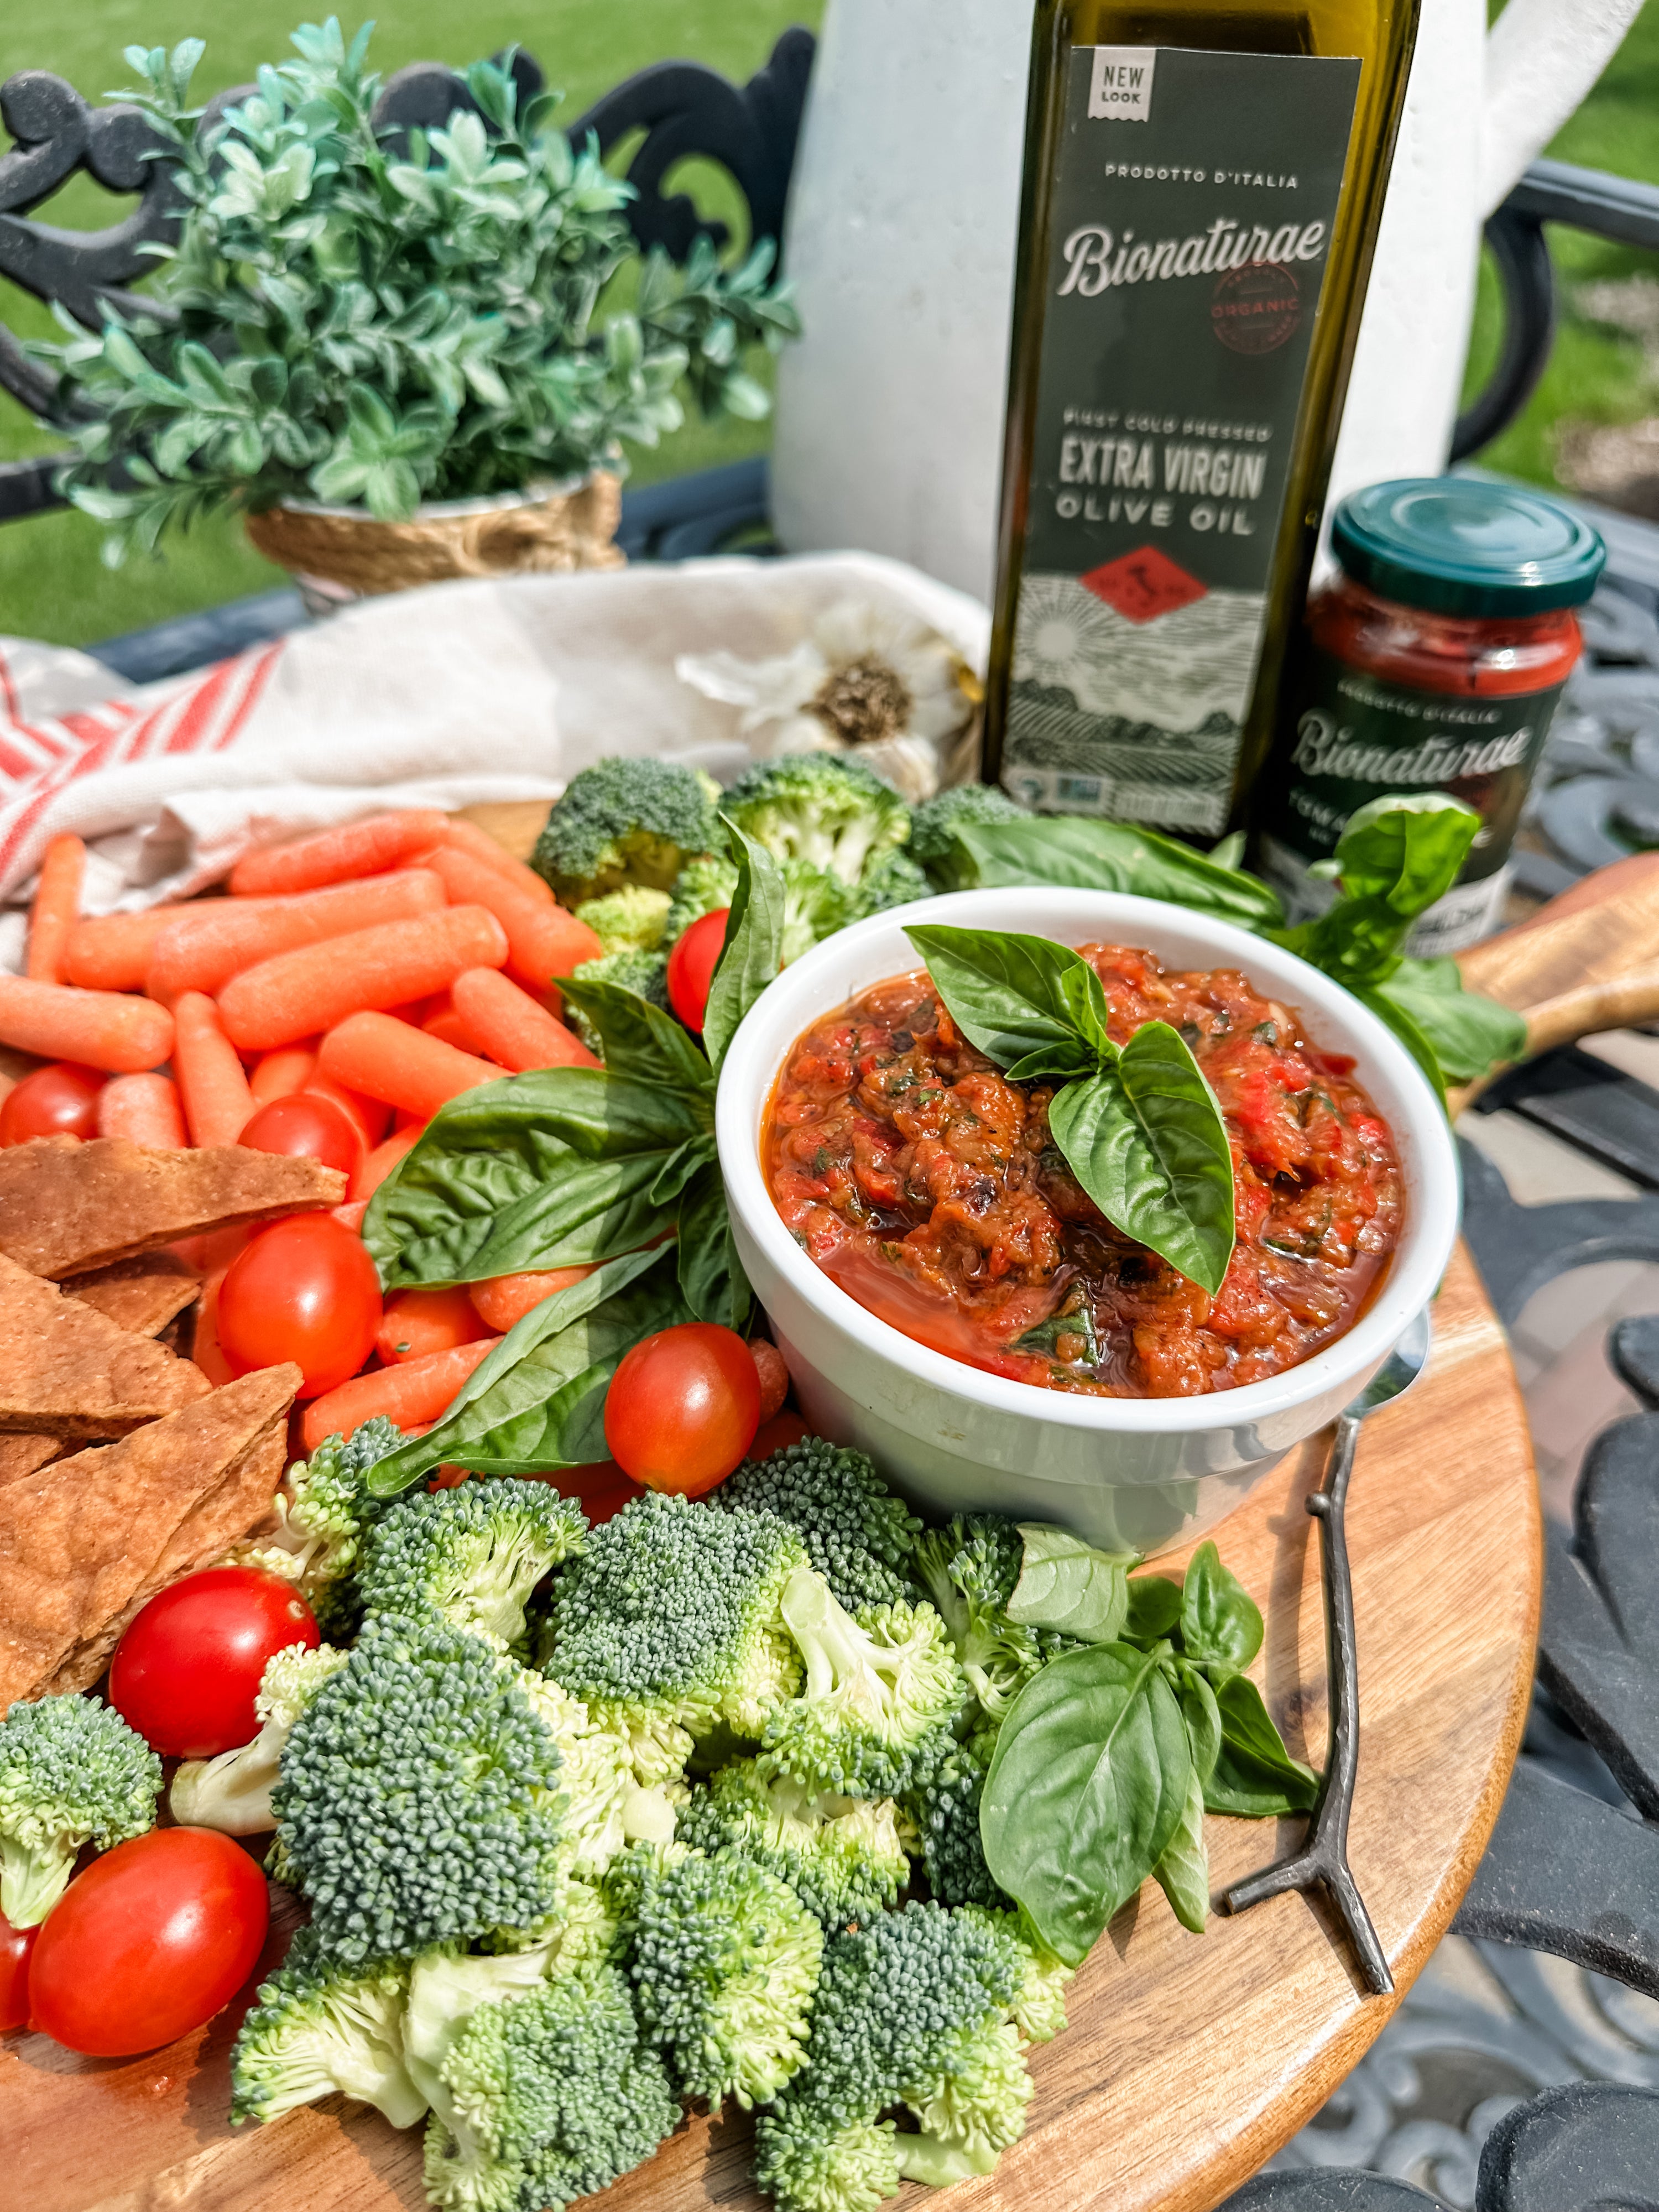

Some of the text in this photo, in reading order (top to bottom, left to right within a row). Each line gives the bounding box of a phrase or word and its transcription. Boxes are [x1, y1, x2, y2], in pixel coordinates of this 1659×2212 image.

[1103, 66, 1144, 88] NEW
[1101, 91, 1140, 105] LOOK
[1105, 164, 1298, 189] PRODOTTO D'ITALIA
[1057, 218, 1326, 296] Bionaturae
[1212, 298, 1298, 317] ORGANIC
[1183, 418, 1272, 442] PRESSED
[1060, 435, 1266, 500] EXTRA VIRGIN
[1056, 491, 1256, 536] OLIVE OIL
[1291, 709, 1534, 784] Bionaturae
